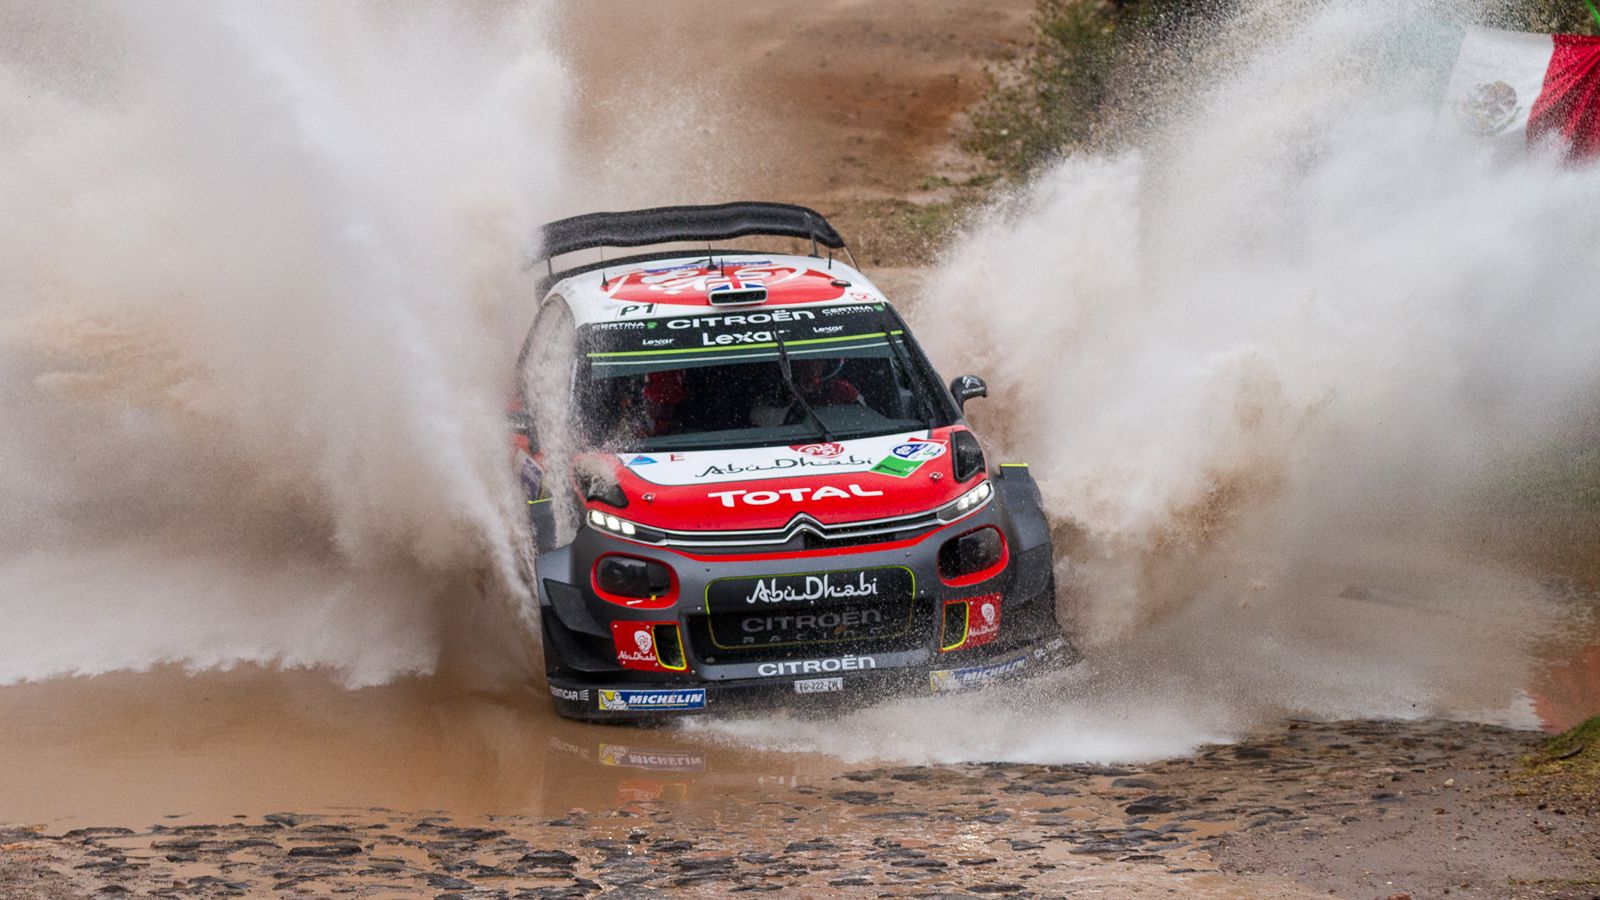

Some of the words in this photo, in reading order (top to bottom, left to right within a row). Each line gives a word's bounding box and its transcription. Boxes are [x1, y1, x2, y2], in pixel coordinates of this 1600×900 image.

[620, 303, 655, 316] P1
[822, 304, 873, 315] CERTINA
[666, 310, 816, 330] CITROËN
[813, 325, 844, 333] Lexar
[642, 338, 674, 346] Lexar
[708, 484, 884, 507] TOTAL
[758, 654, 876, 676] CITROËN
[628, 693, 702, 705] MICHELIN
